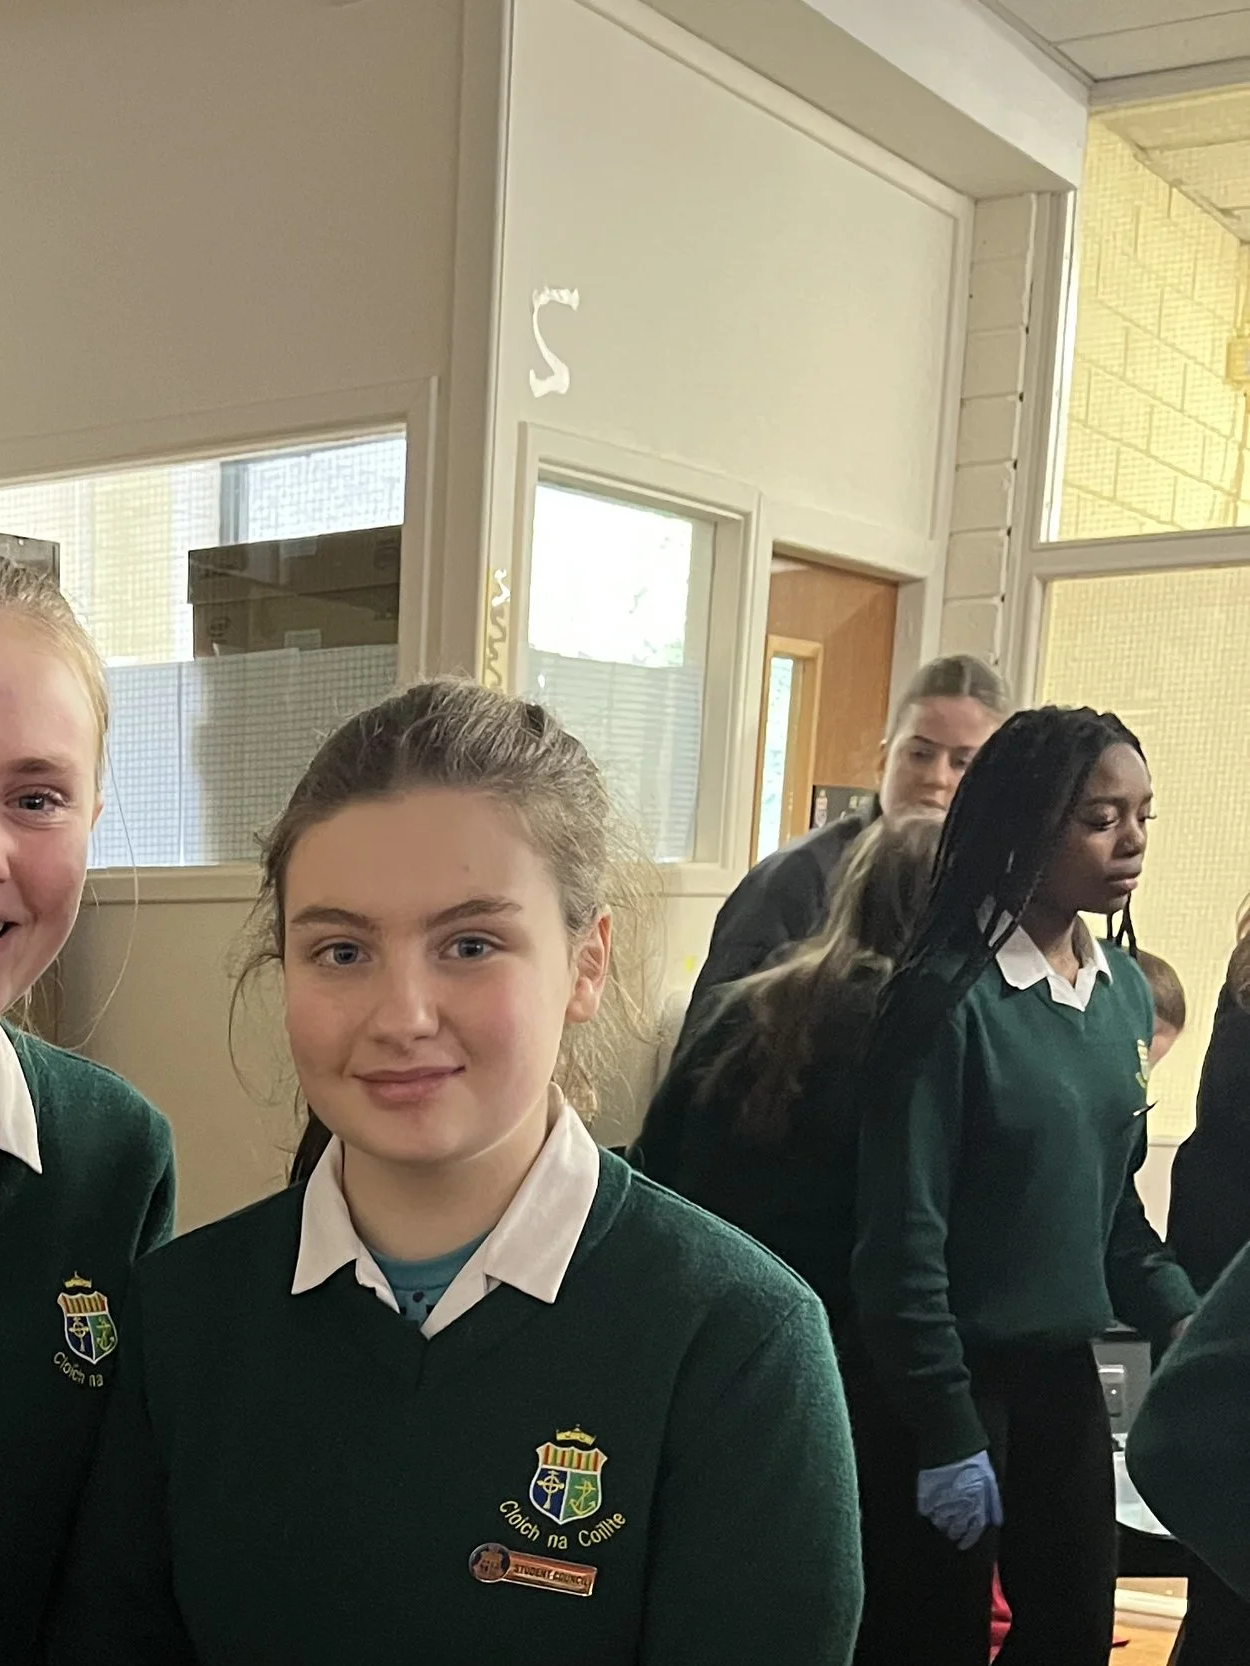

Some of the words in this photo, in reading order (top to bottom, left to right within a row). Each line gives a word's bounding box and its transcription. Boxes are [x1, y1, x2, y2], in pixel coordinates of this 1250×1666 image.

[500, 1500, 541, 1542] Cloich
[547, 1533, 568, 1549] na
[578, 1512, 626, 1547] Coillte
[514, 1563, 551, 1580] STUDENT
[553, 1569, 589, 1587] COUNCIL
